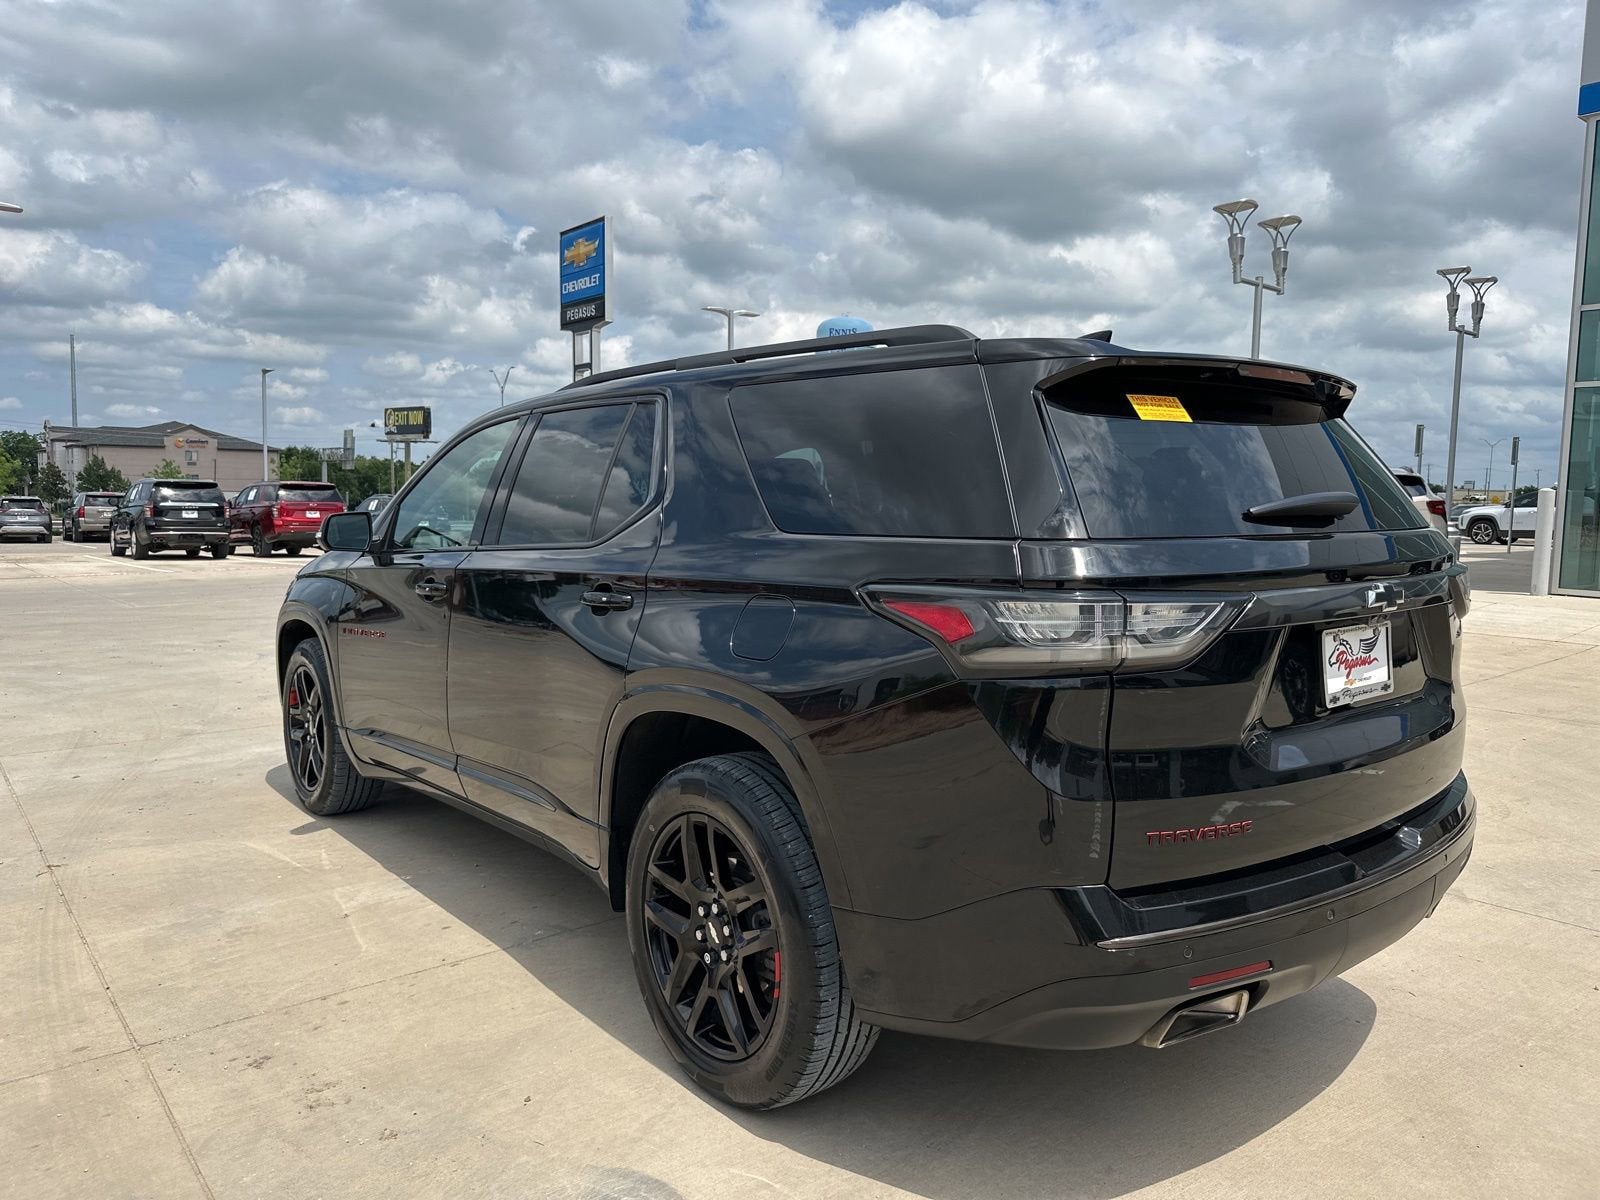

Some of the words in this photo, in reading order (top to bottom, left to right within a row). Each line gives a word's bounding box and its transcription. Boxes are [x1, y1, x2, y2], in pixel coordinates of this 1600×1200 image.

[562, 274, 600, 294] CHEVROLET
[566, 305, 596, 321] PEGASUS
[829, 327, 857, 336] ENNIS
[1148, 396, 1180, 404] VEHICLE
[394, 410, 408, 425] EXIT
[408, 410, 424, 425] NOW
[1335, 650, 1379, 679] Pegasus
[1146, 820, 1253, 847] TRAVERSE
